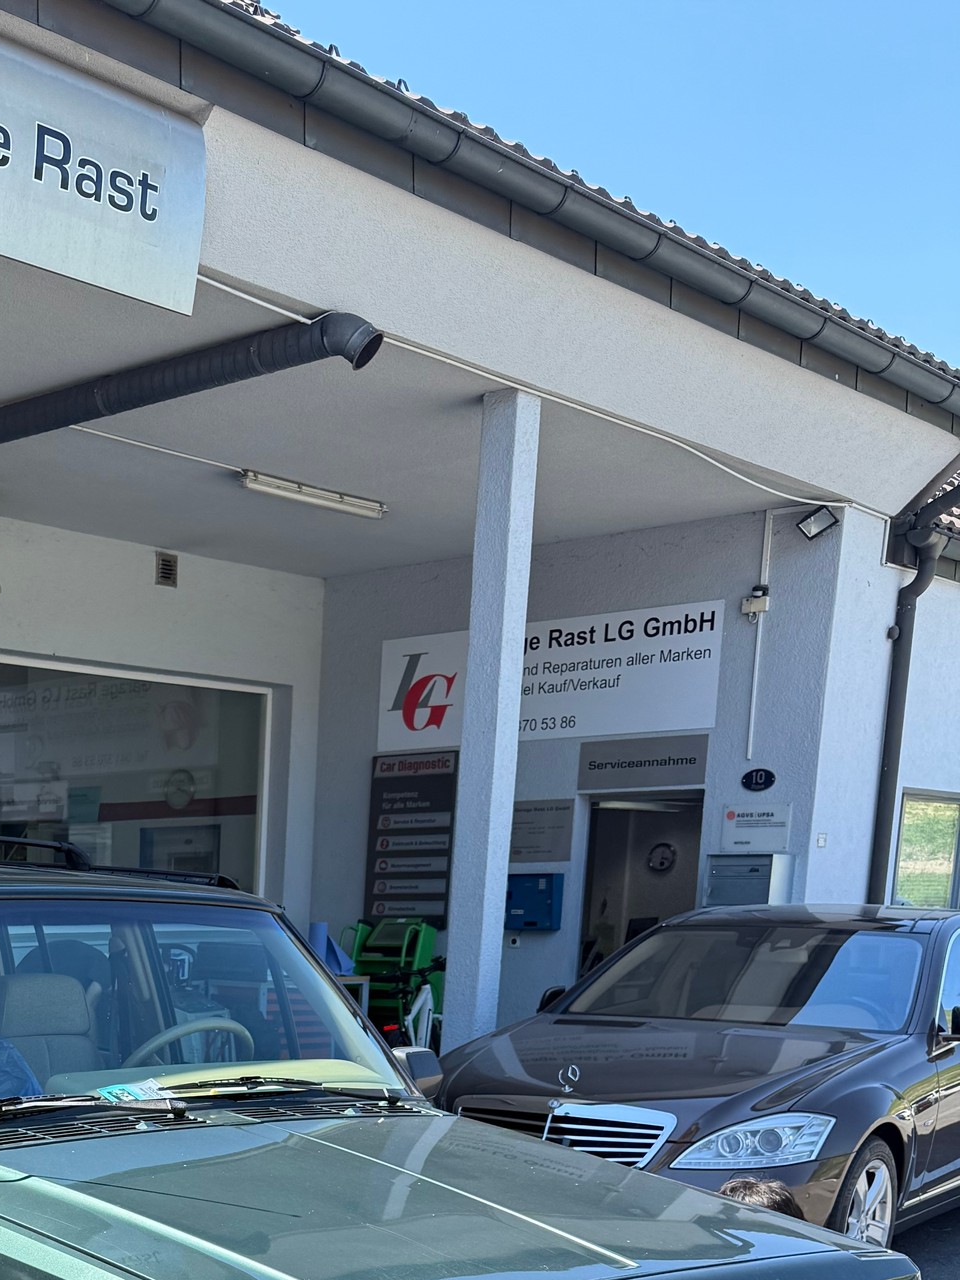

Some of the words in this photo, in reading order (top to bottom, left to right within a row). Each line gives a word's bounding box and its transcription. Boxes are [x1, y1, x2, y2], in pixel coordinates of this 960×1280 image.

[33, 121, 160, 223] Rast
[548, 625, 596, 649] Rast
[603, 620, 635, 643] LG
[643, 610, 716, 638] GmbH
[523, 663, 538, 678] nd
[542, 656, 622, 676] Reparaturen
[626, 652, 655, 667] aller
[659, 647, 711, 664] Marken
[538, 674, 621, 695] Kauf/Verkauf
[541, 717, 556, 731] 53
[560, 715, 576, 729] 86
[380, 761, 396, 773] Car
[398, 757, 450, 773] Diagnostic
[588, 756, 697, 771] Serviceannahme
[752, 770, 765, 784] 10
